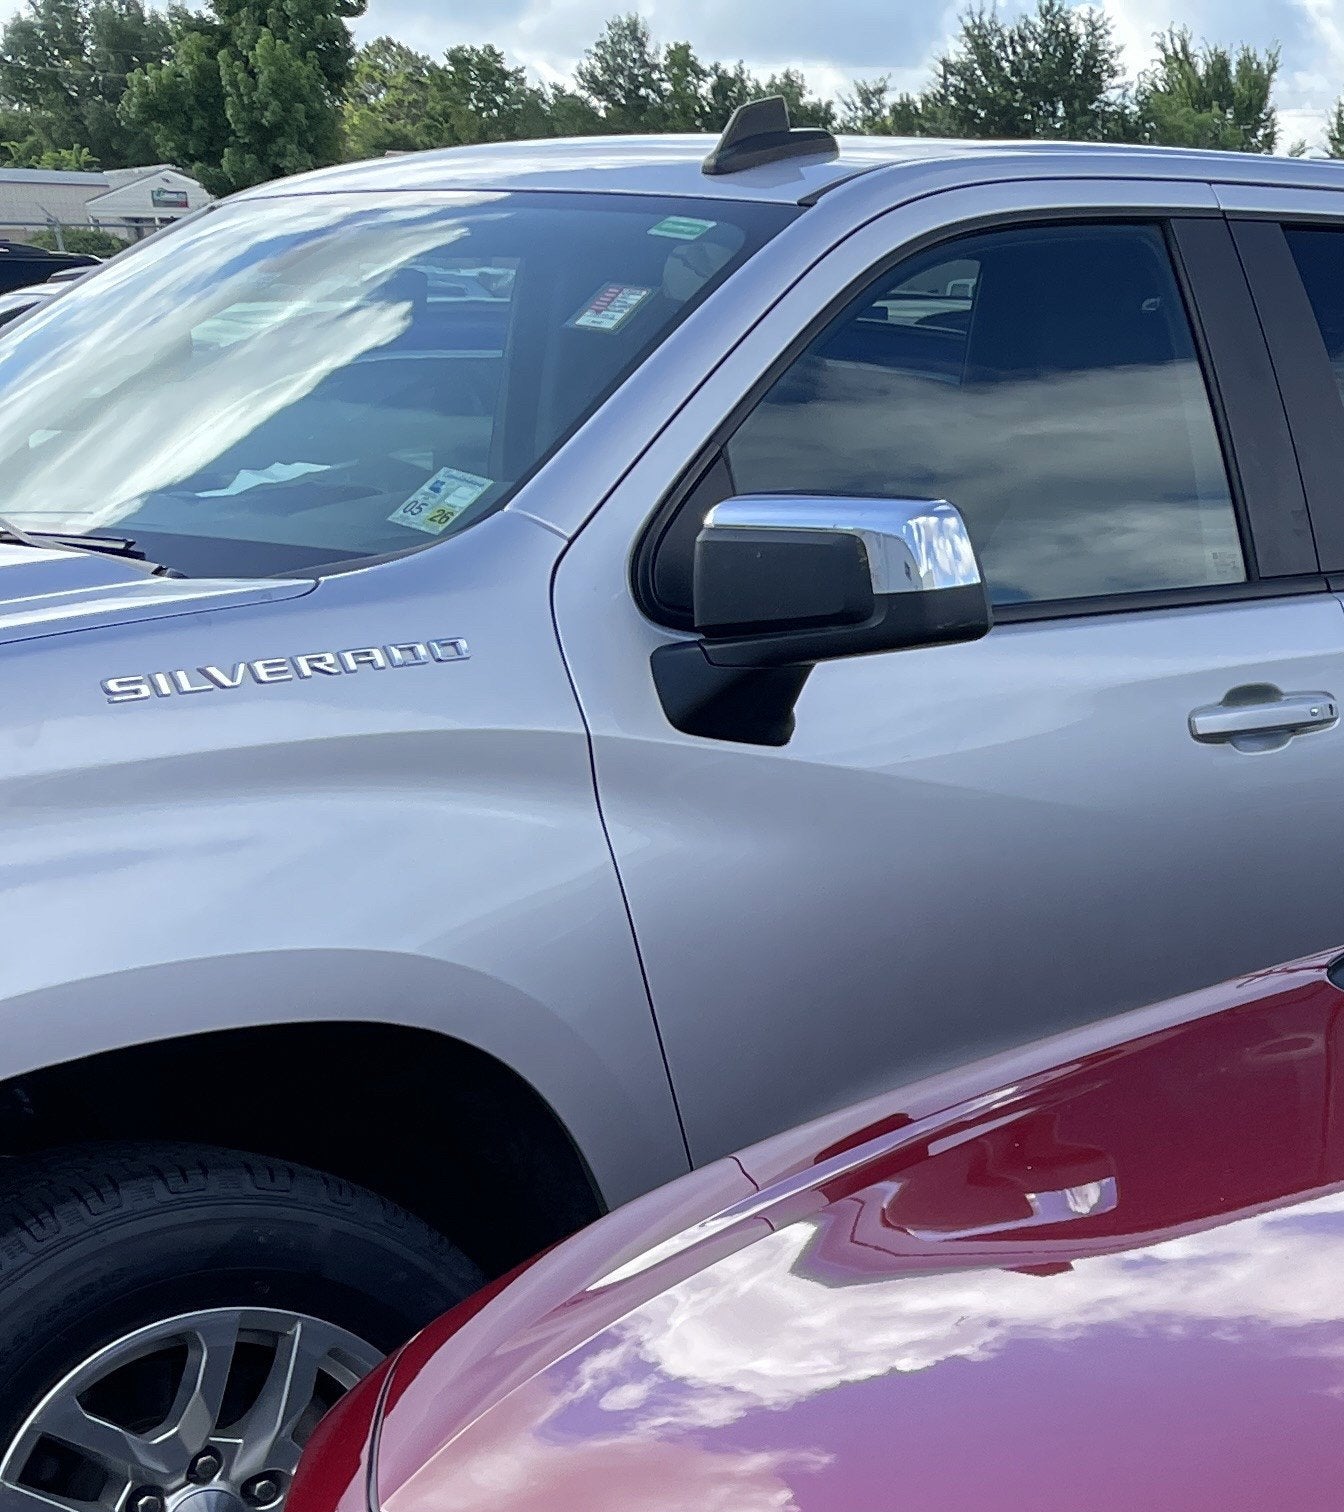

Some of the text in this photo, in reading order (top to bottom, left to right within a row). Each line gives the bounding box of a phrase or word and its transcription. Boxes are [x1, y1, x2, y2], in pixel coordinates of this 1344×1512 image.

[403, 500, 454, 525] 05 26
[100, 636, 472, 704] SILVERADO
